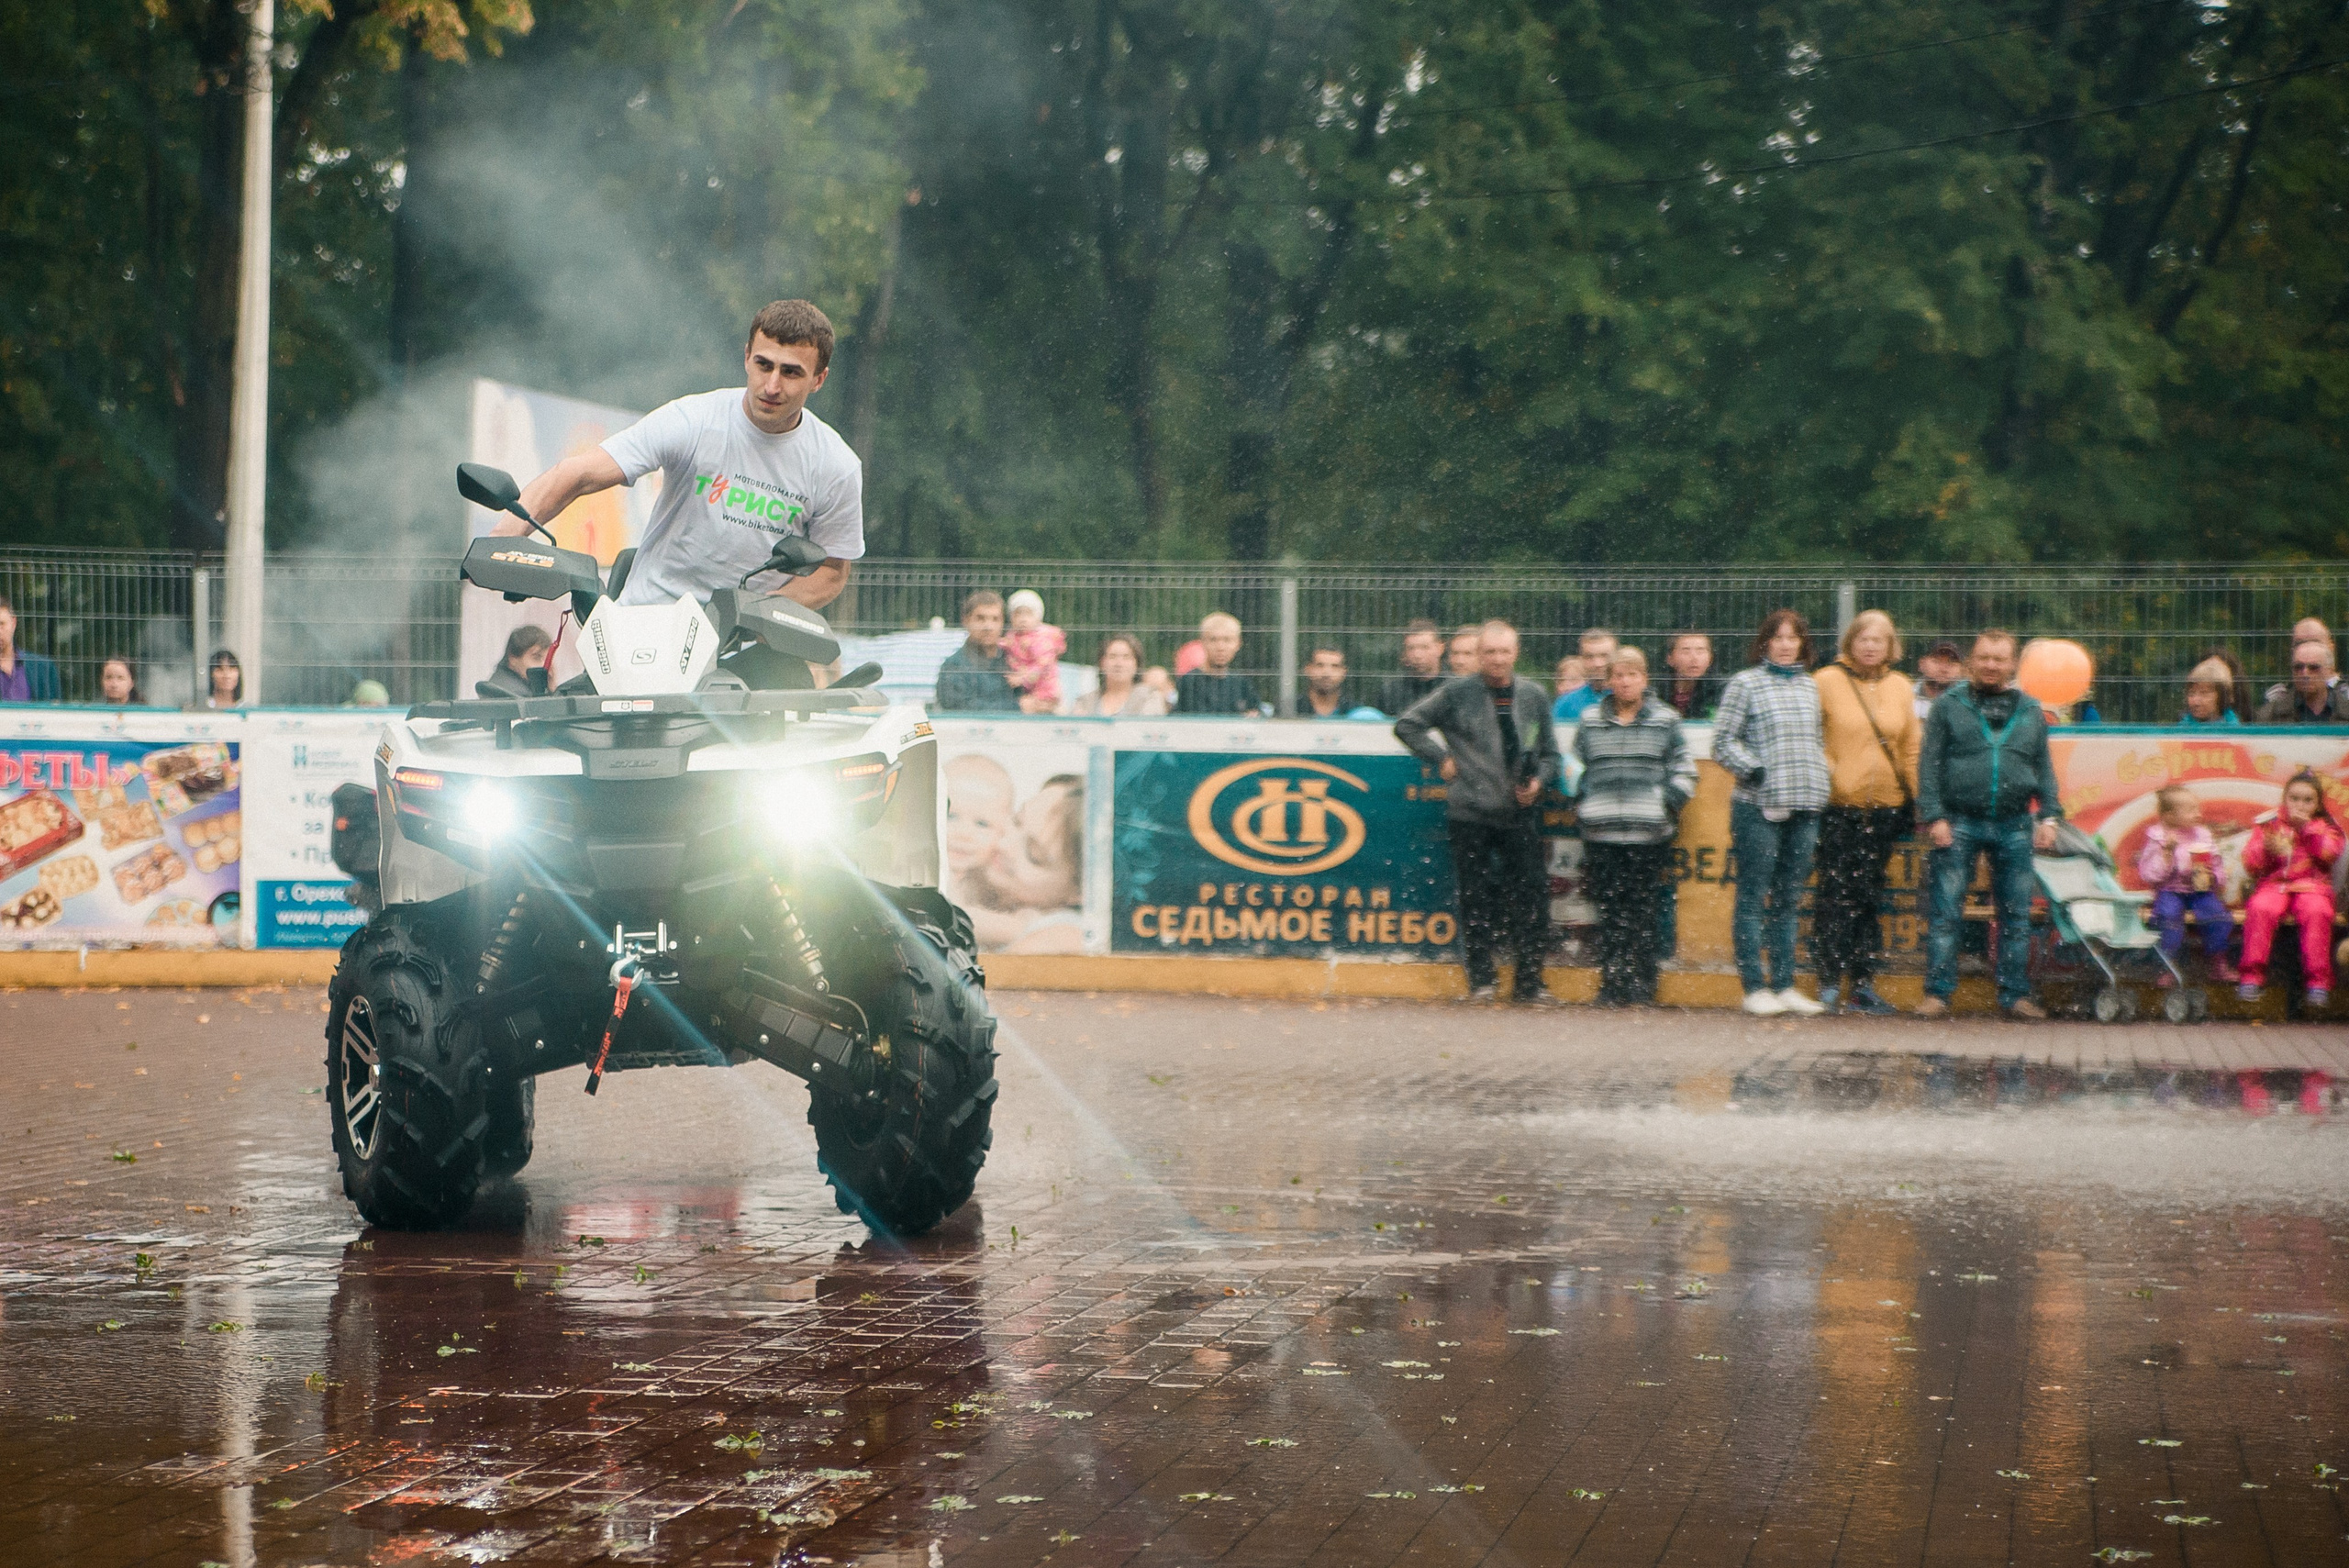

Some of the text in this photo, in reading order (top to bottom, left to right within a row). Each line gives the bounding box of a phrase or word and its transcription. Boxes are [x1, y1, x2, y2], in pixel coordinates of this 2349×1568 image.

[734, 473, 808, 504] МОТОВЕЛОМАРКЕТ
[1198, 882, 1391, 909] РЕСТОРАН
[1131, 905, 1457, 946] СЕДЬМОЕ НЕБО
